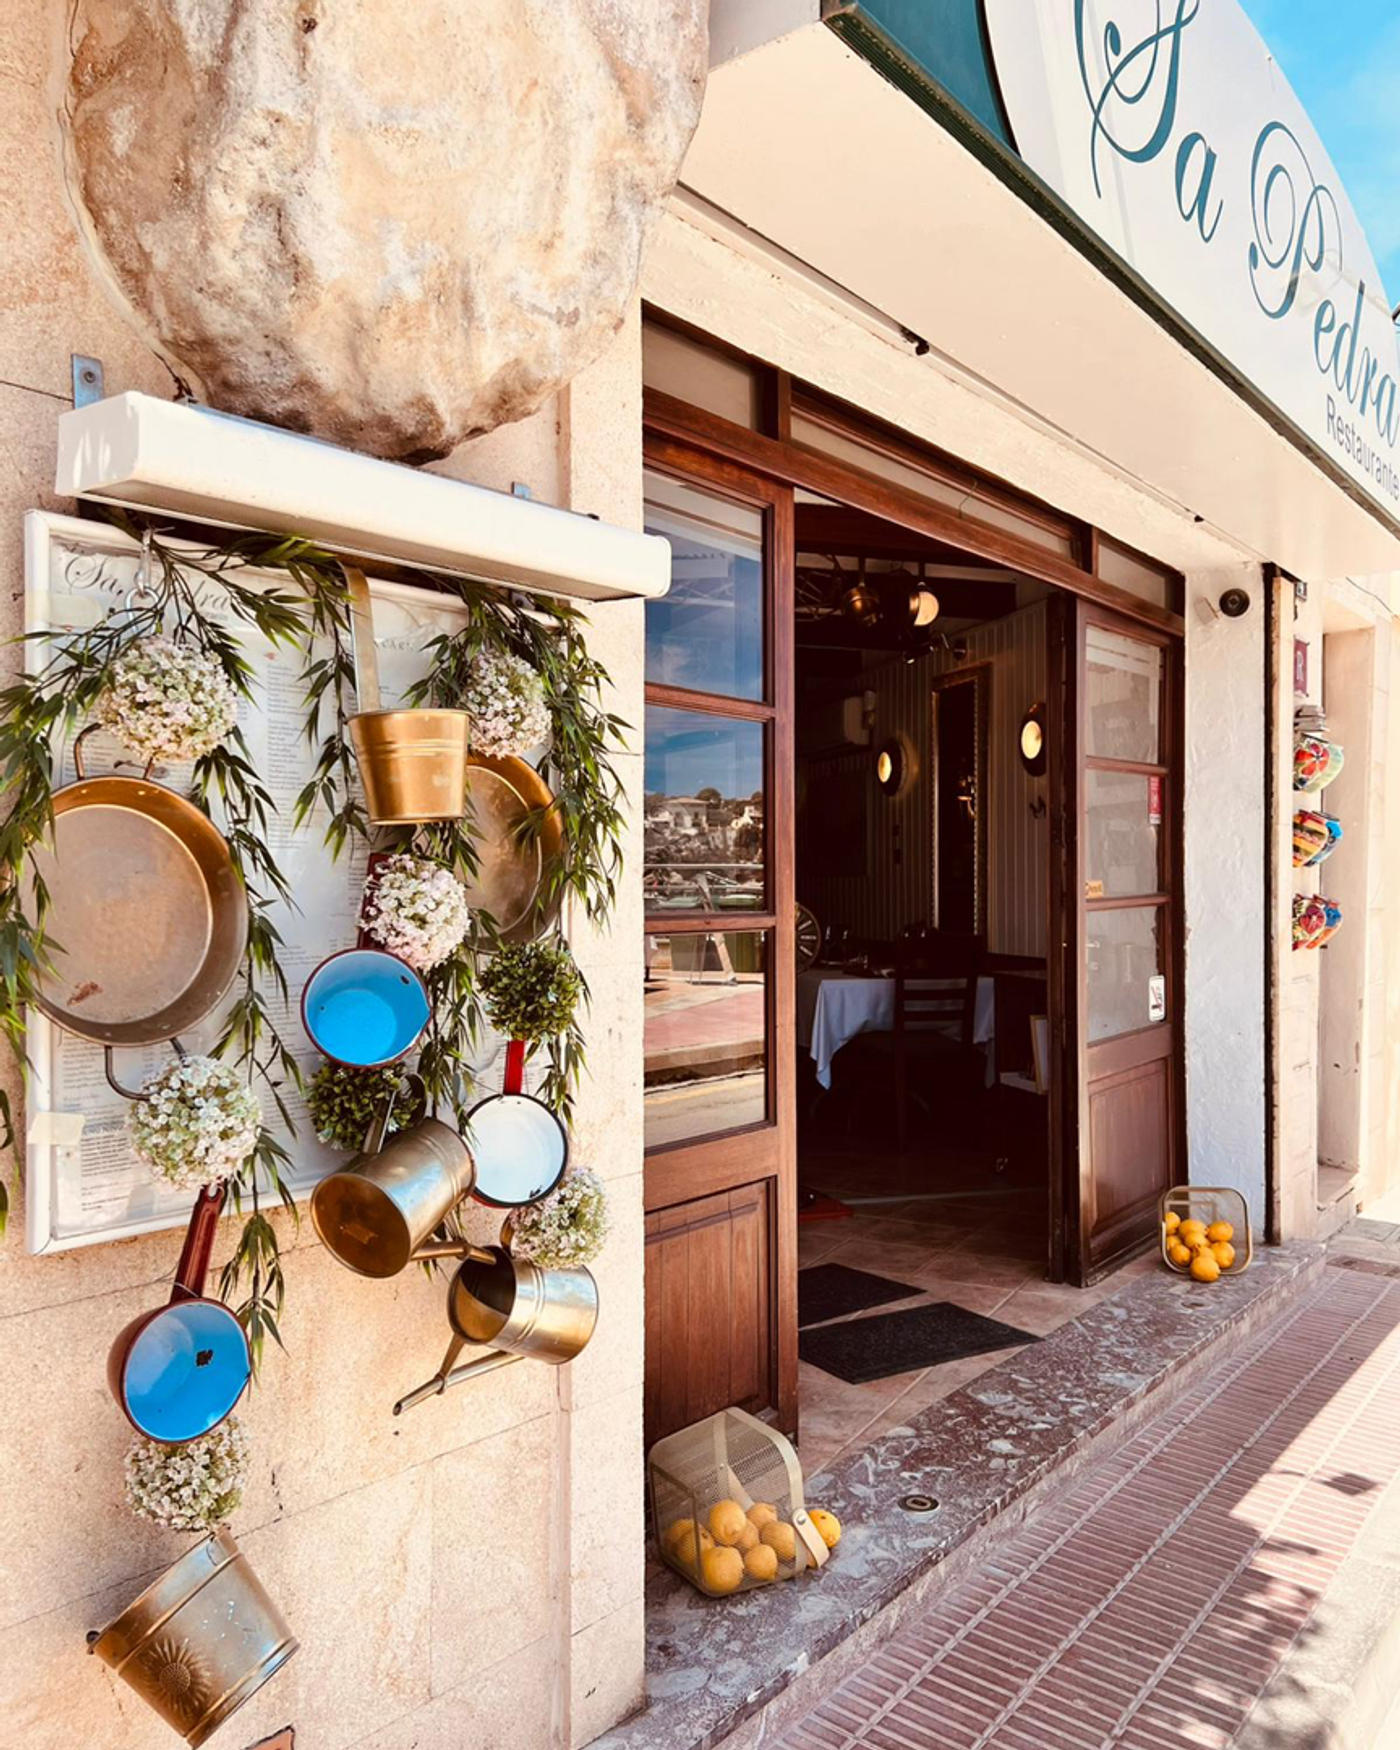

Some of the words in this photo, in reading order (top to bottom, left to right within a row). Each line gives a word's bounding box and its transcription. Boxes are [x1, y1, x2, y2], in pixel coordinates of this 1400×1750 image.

[1074, 0, 1223, 243] Sa
[1248, 120, 1400, 448] Pedra
[1326, 394, 1400, 501] Restaurante
